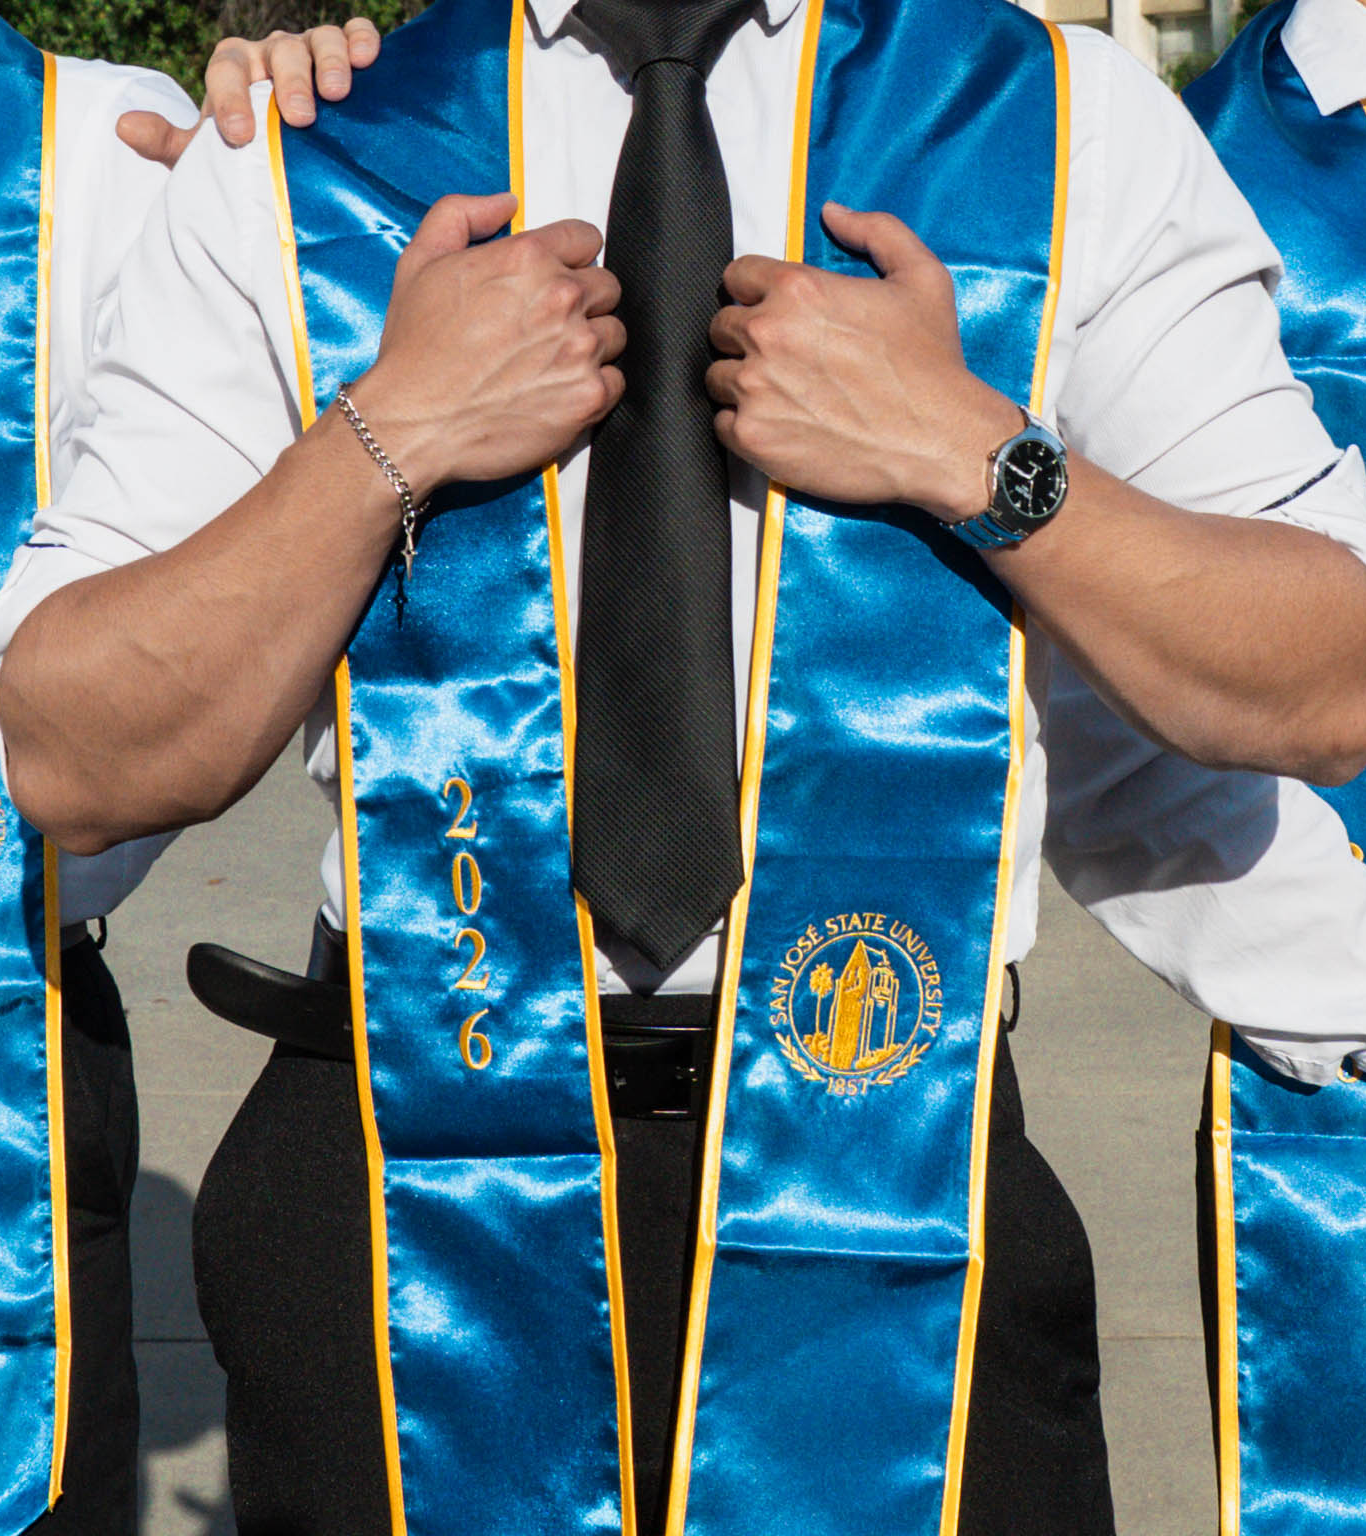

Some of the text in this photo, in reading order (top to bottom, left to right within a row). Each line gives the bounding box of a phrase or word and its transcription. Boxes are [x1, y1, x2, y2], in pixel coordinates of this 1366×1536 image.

[442, 776, 493, 1071] 2026
[769, 912, 944, 1038] SAN JOSÉ STATE UNIVERSITY
[826, 1075, 869, 1097] 1857
